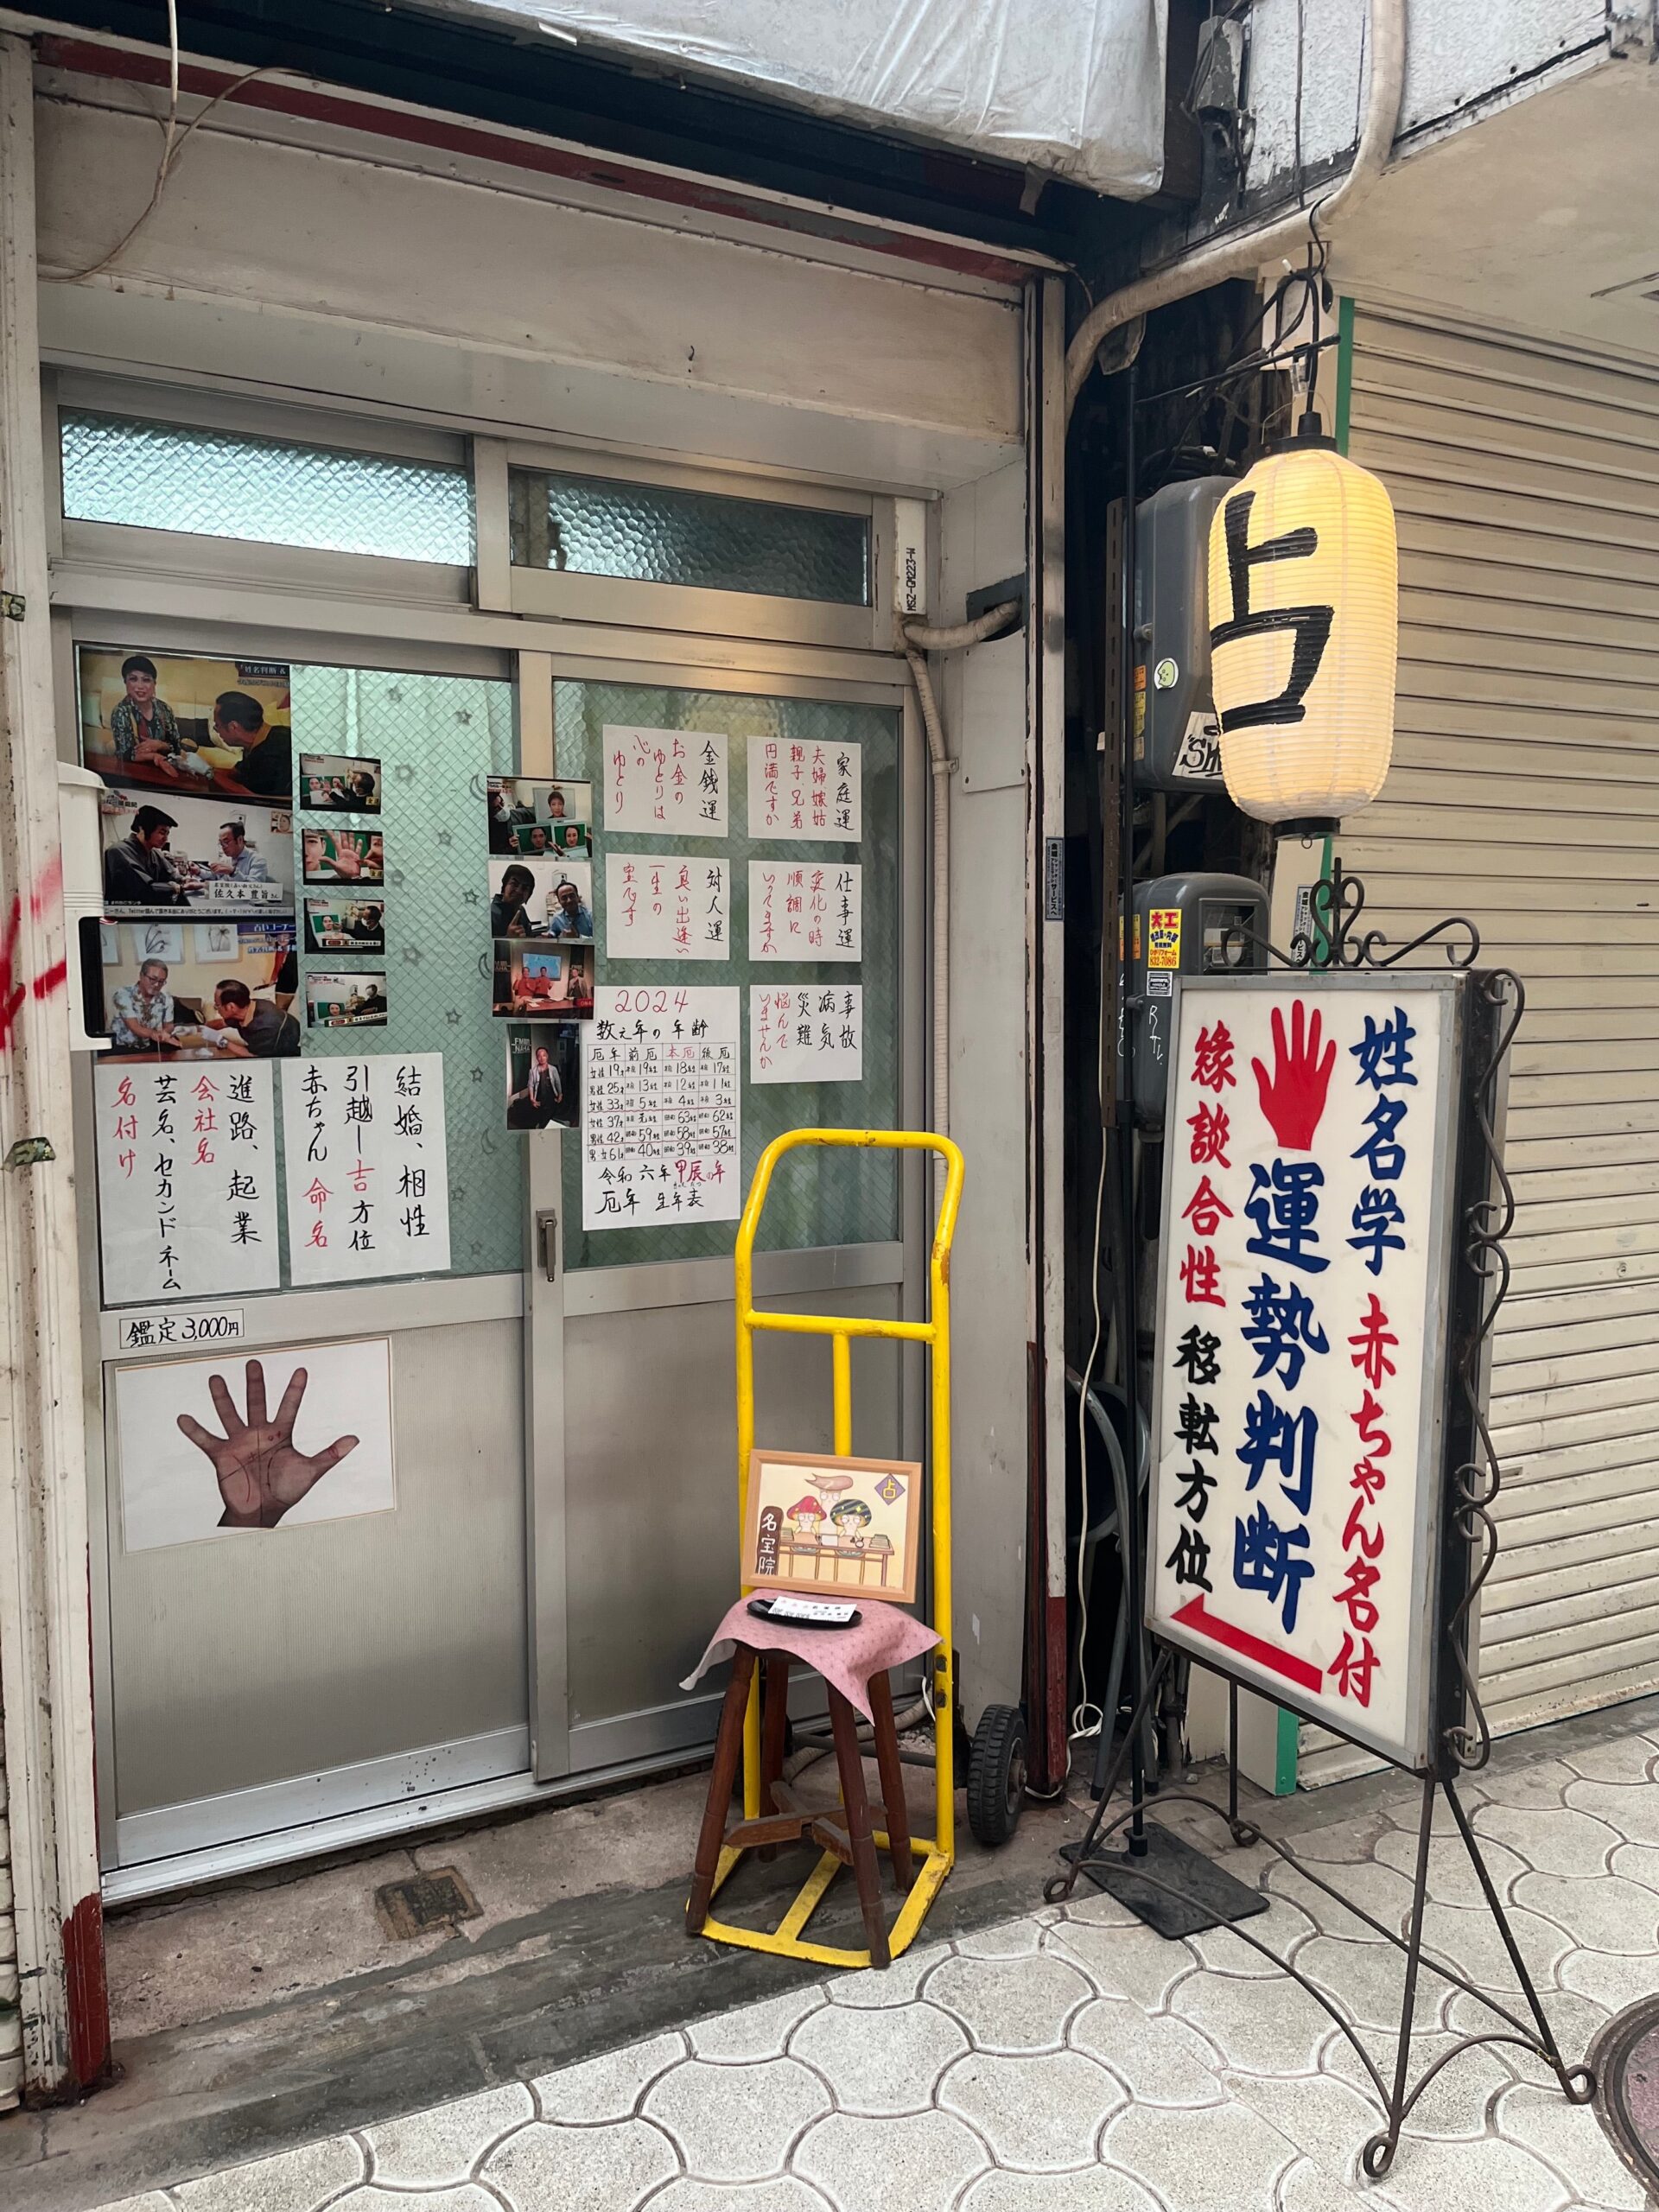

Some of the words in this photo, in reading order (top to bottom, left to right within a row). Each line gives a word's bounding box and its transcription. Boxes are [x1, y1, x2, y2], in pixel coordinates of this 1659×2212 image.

[1211, 491, 1333, 734] 占
[613, 749, 626, 815] ゆとり
[632, 734, 651, 766] 心の
[671, 739, 688, 805] お金の
[697, 740, 722, 822] 金銭運
[652, 749, 667, 821] ゆとりは
[764, 743, 779, 828] 円満ですか
[833, 752, 855, 831] 家庭運
[622, 863, 638, 927] 宝です
[648, 865, 665, 916] 一生の
[671, 865, 692, 954] 良い出逢い
[705, 868, 725, 942] 対人運
[786, 870, 803, 935] 順調に
[808, 871, 827, 947] 変化の時
[835, 871, 854, 950] 仕事運
[1151, 911, 1178, 929] 大工
[1150, 956, 1177, 966] 832-7086
[614, 989, 690, 1014] 2024
[759, 994, 774, 1070] いませんか
[775, 992, 790, 1050] 悩んで
[797, 992, 813, 1047] 災難
[817, 992, 836, 1051] 病気
[839, 992, 858, 1051] 事故
[111, 1077, 138, 1179] 名付け
[190, 1075, 220, 1165] 会社名
[1344, 1006, 1418, 1276] 姓名学
[1232, 1159, 1331, 1634] 運勢判断
[882, 1478, 896, 1499] 占
[1327, 1294, 1400, 1708] 赤ちゃん名付
[758, 1512, 777, 1576] 名宝院
